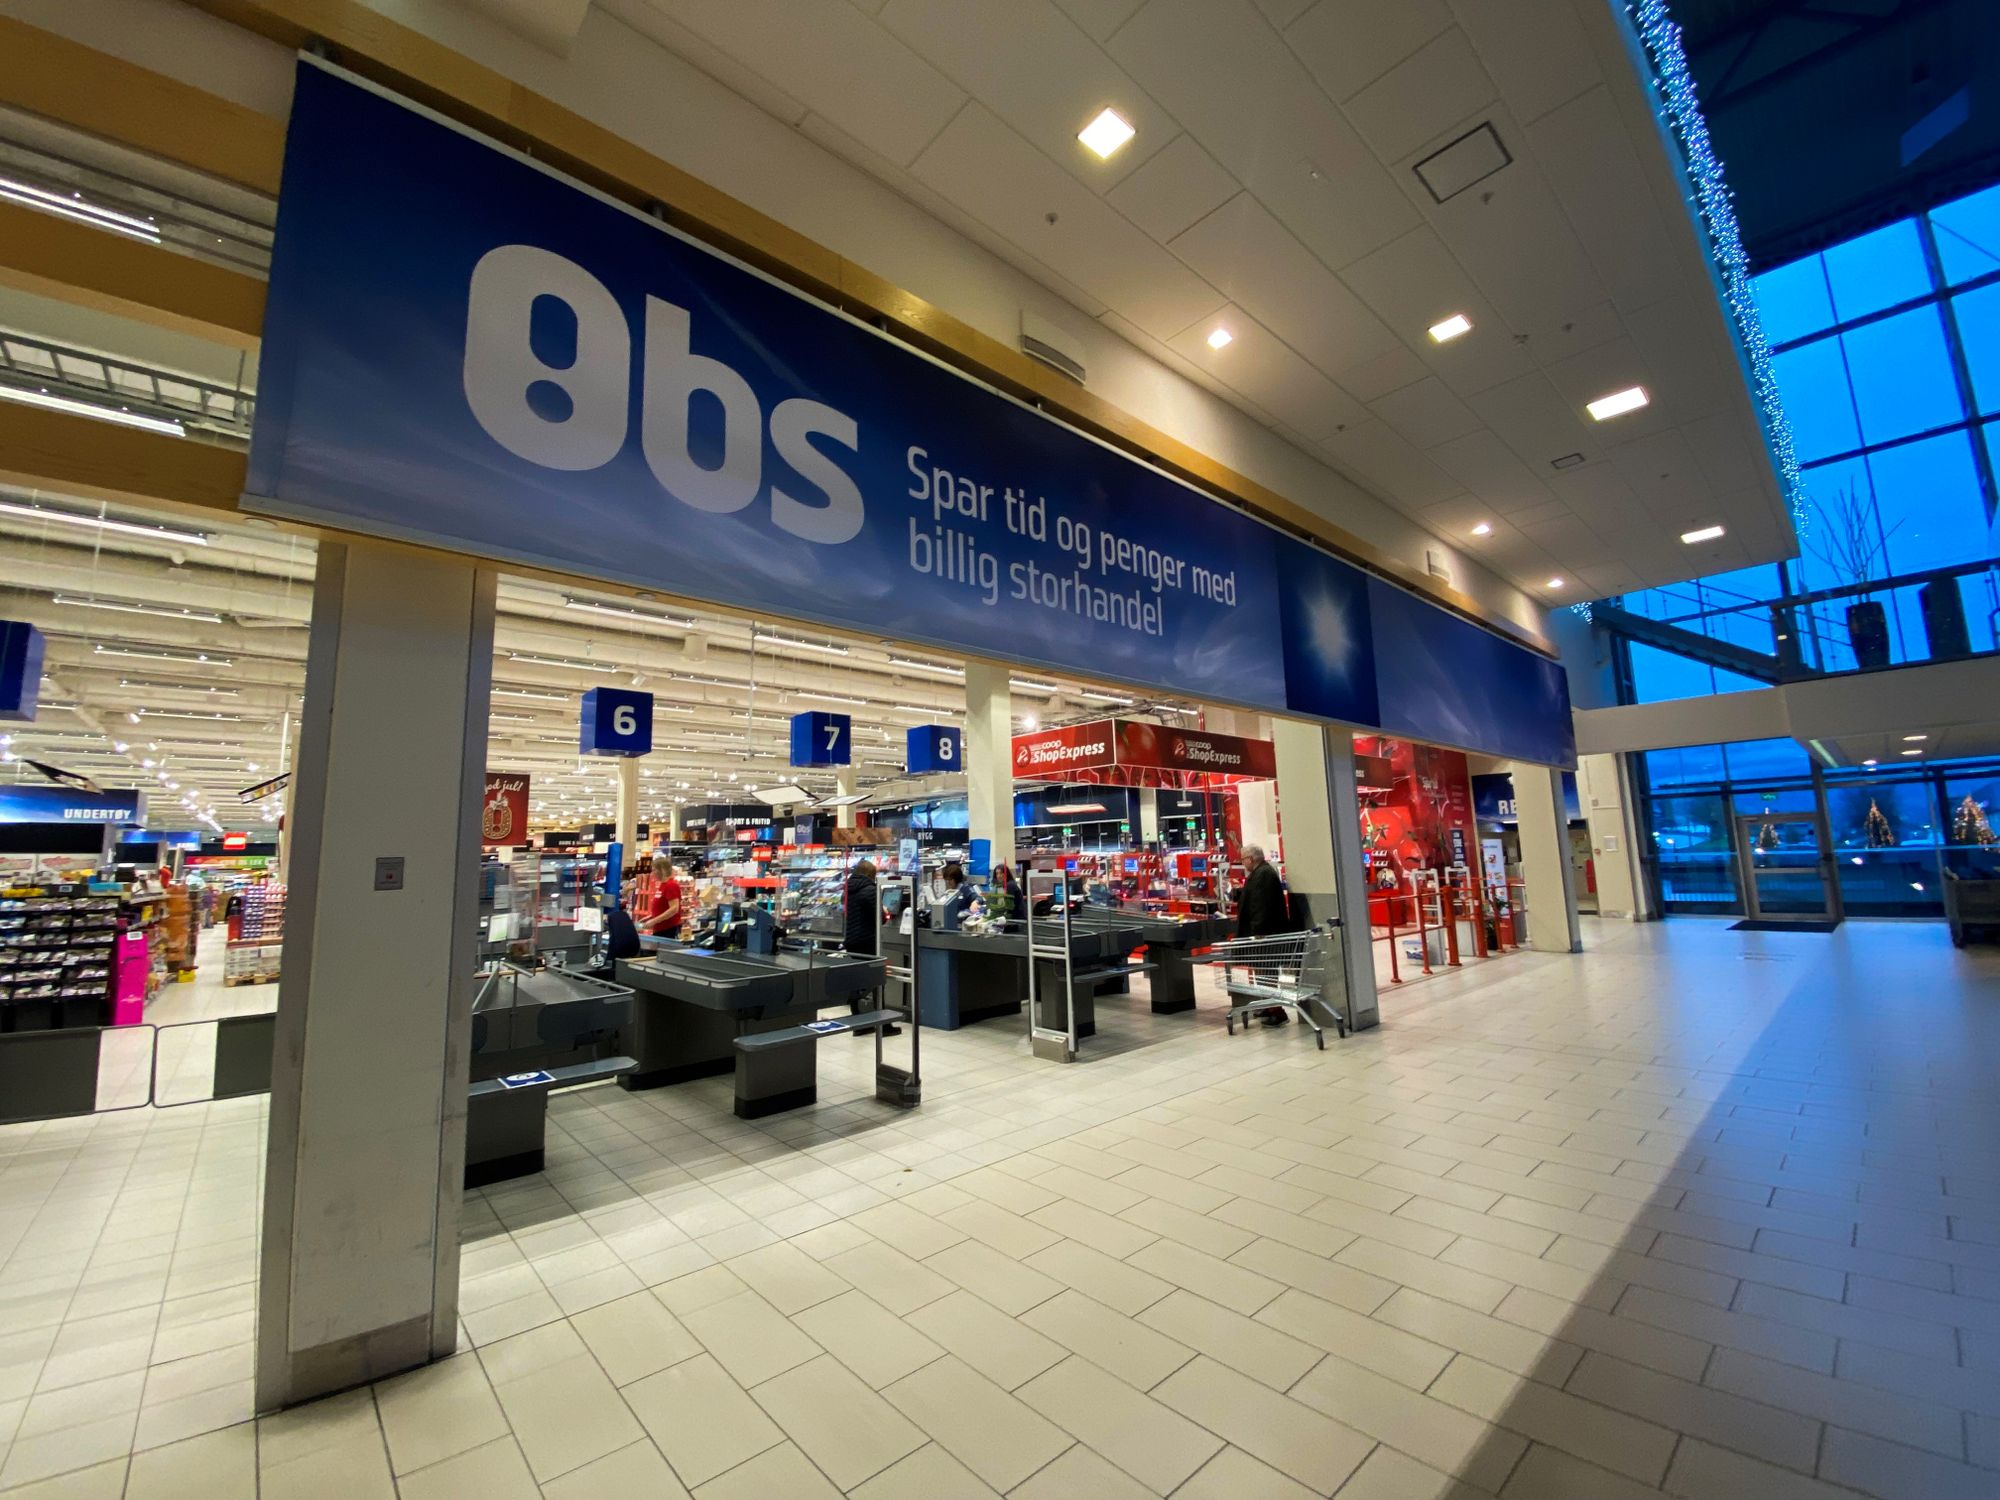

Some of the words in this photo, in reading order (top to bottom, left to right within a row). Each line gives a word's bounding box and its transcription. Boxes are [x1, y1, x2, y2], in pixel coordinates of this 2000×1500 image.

[463, 244, 865, 544] Obs
[907, 445, 994, 521] Spar
[1004, 487, 1046, 542] tid
[1056, 516, 1091, 569] og
[1100, 531, 1185, 593] penger
[1193, 565, 1237, 607] med
[909, 517, 998, 606] billig
[1009, 560, 1164, 636] storhandel
[613, 705, 637, 735] 6
[823, 726, 840, 750] 7
[938, 737, 953, 760] 8
[1033, 742, 1105, 764] ShopExpress
[1189, 747, 1241, 765] ShopExpress
[63, 808, 131, 820] UNDERTØY
